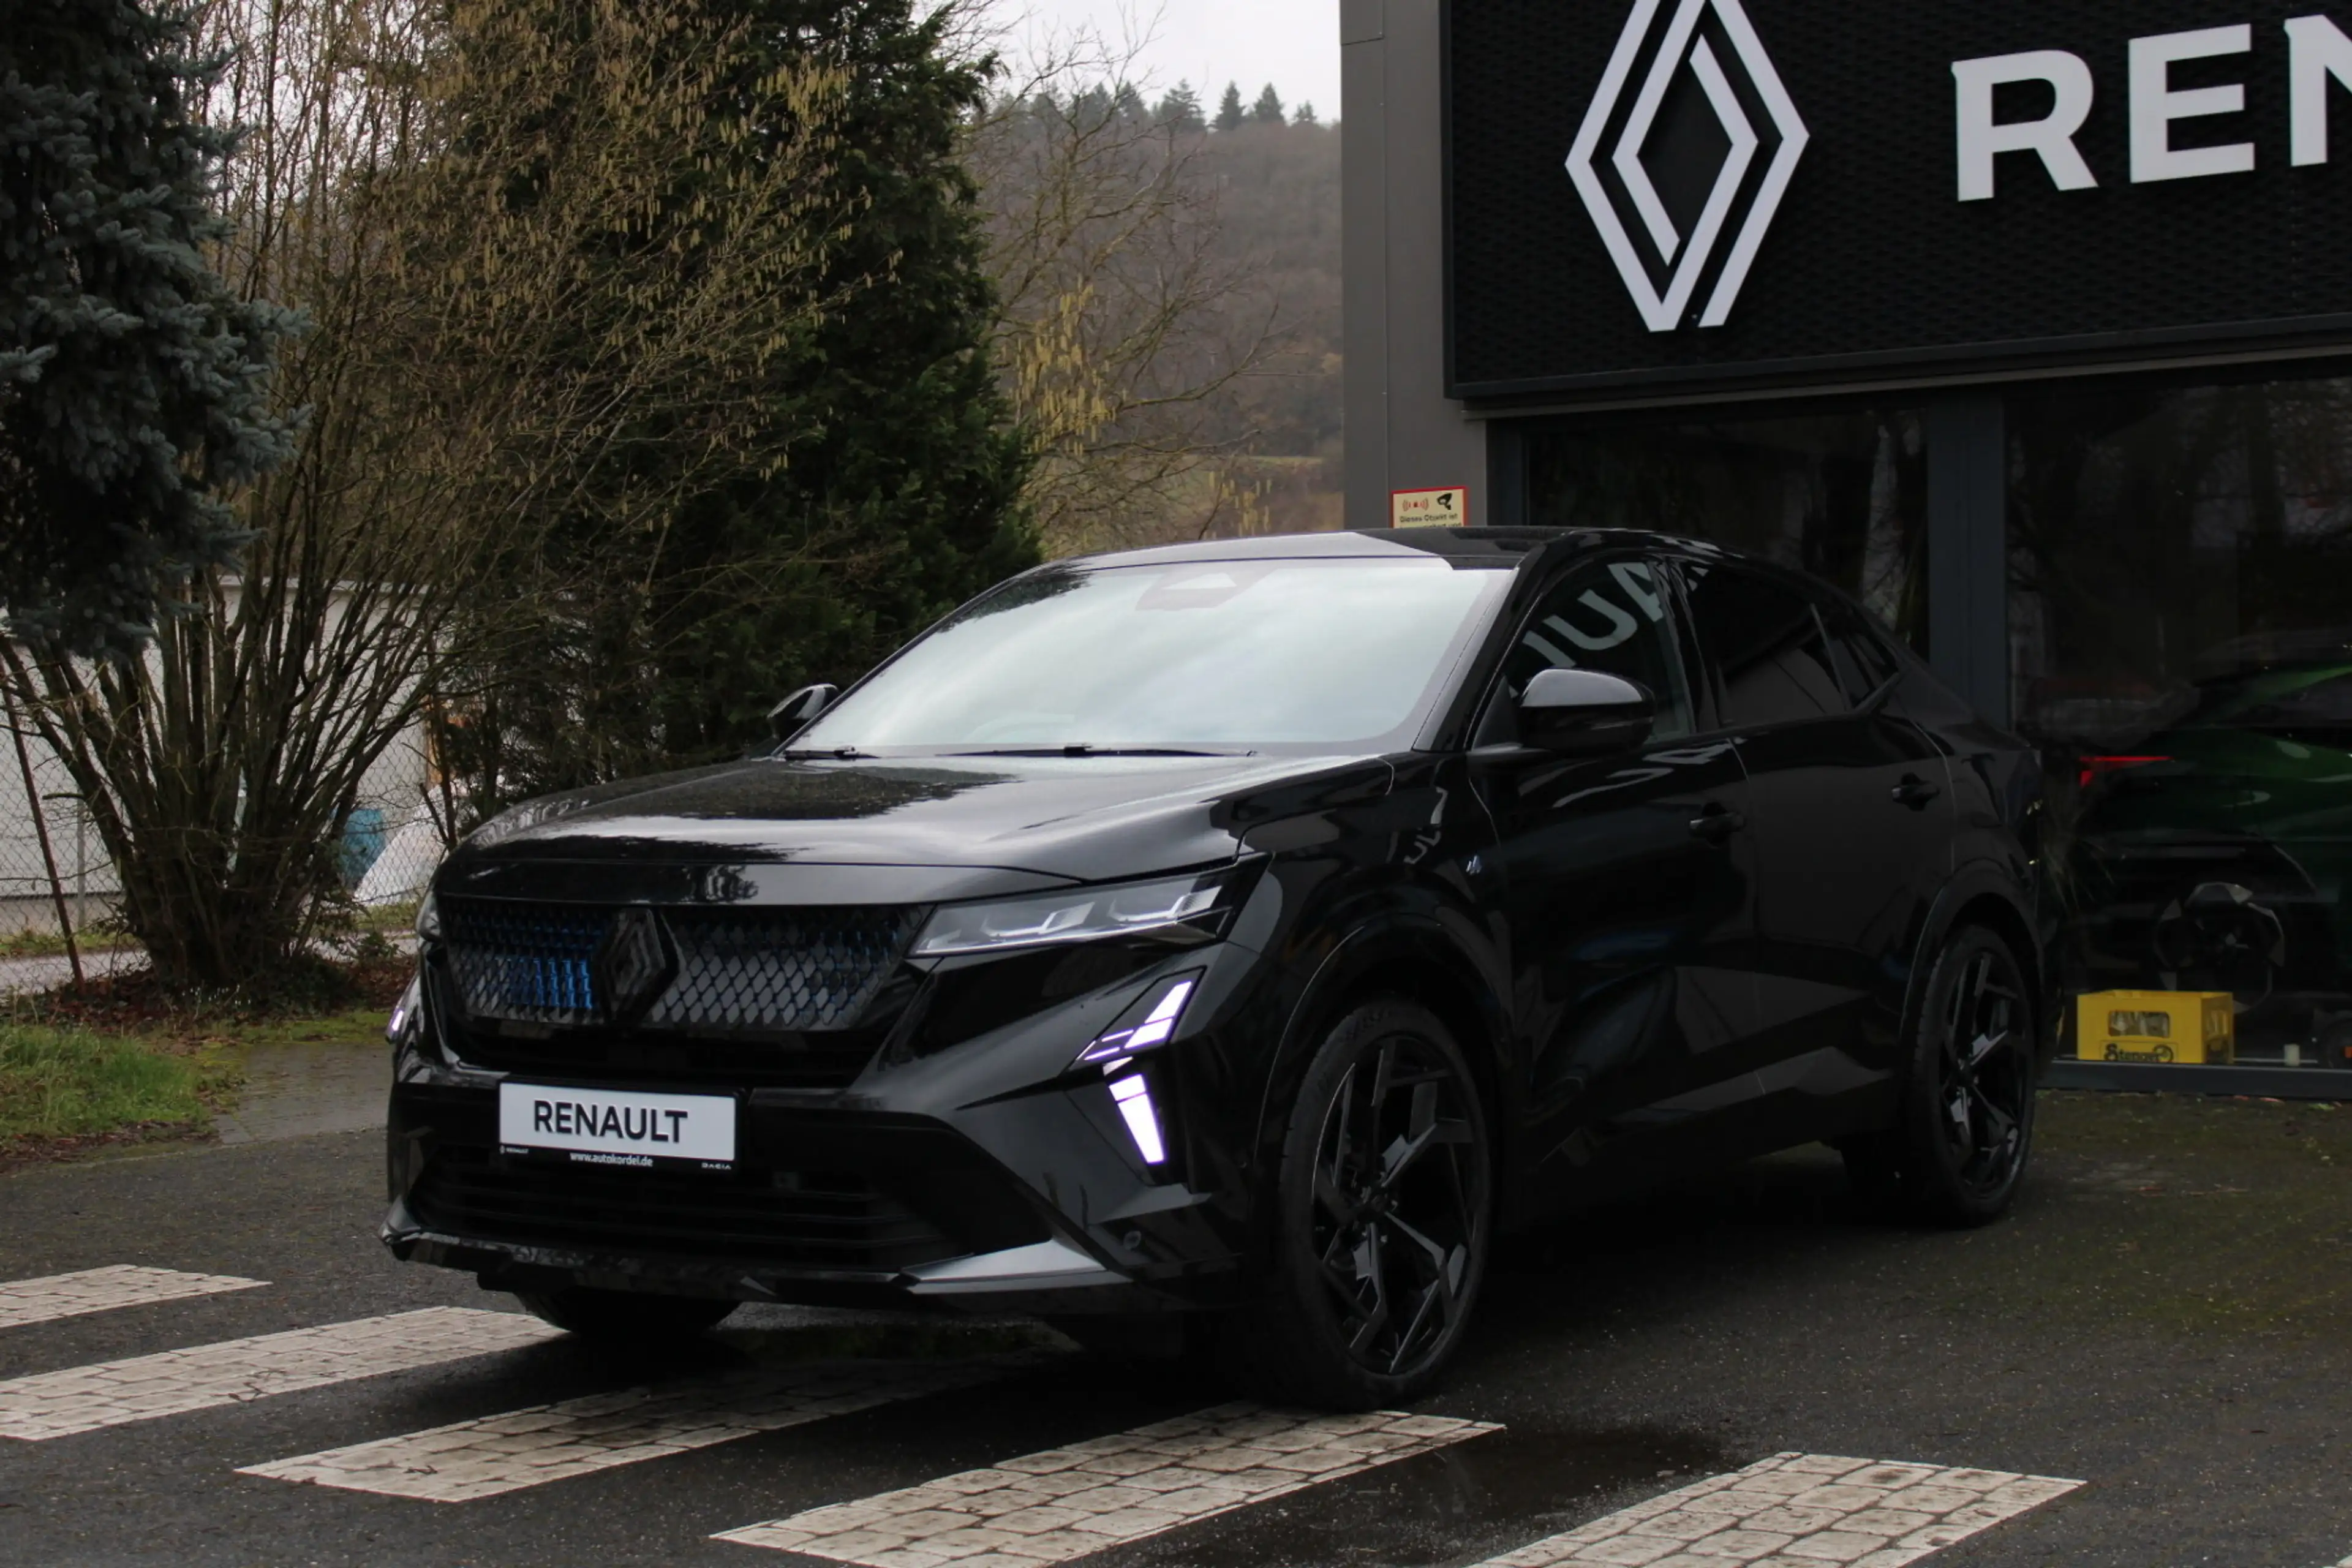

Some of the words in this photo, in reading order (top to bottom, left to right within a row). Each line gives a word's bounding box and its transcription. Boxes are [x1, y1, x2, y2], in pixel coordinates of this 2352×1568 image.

[533, 1100, 688, 1144] RENAULT
[569, 1152, 654, 1167] www.autokordel.de
[701, 1162, 732, 1170] DACIA
